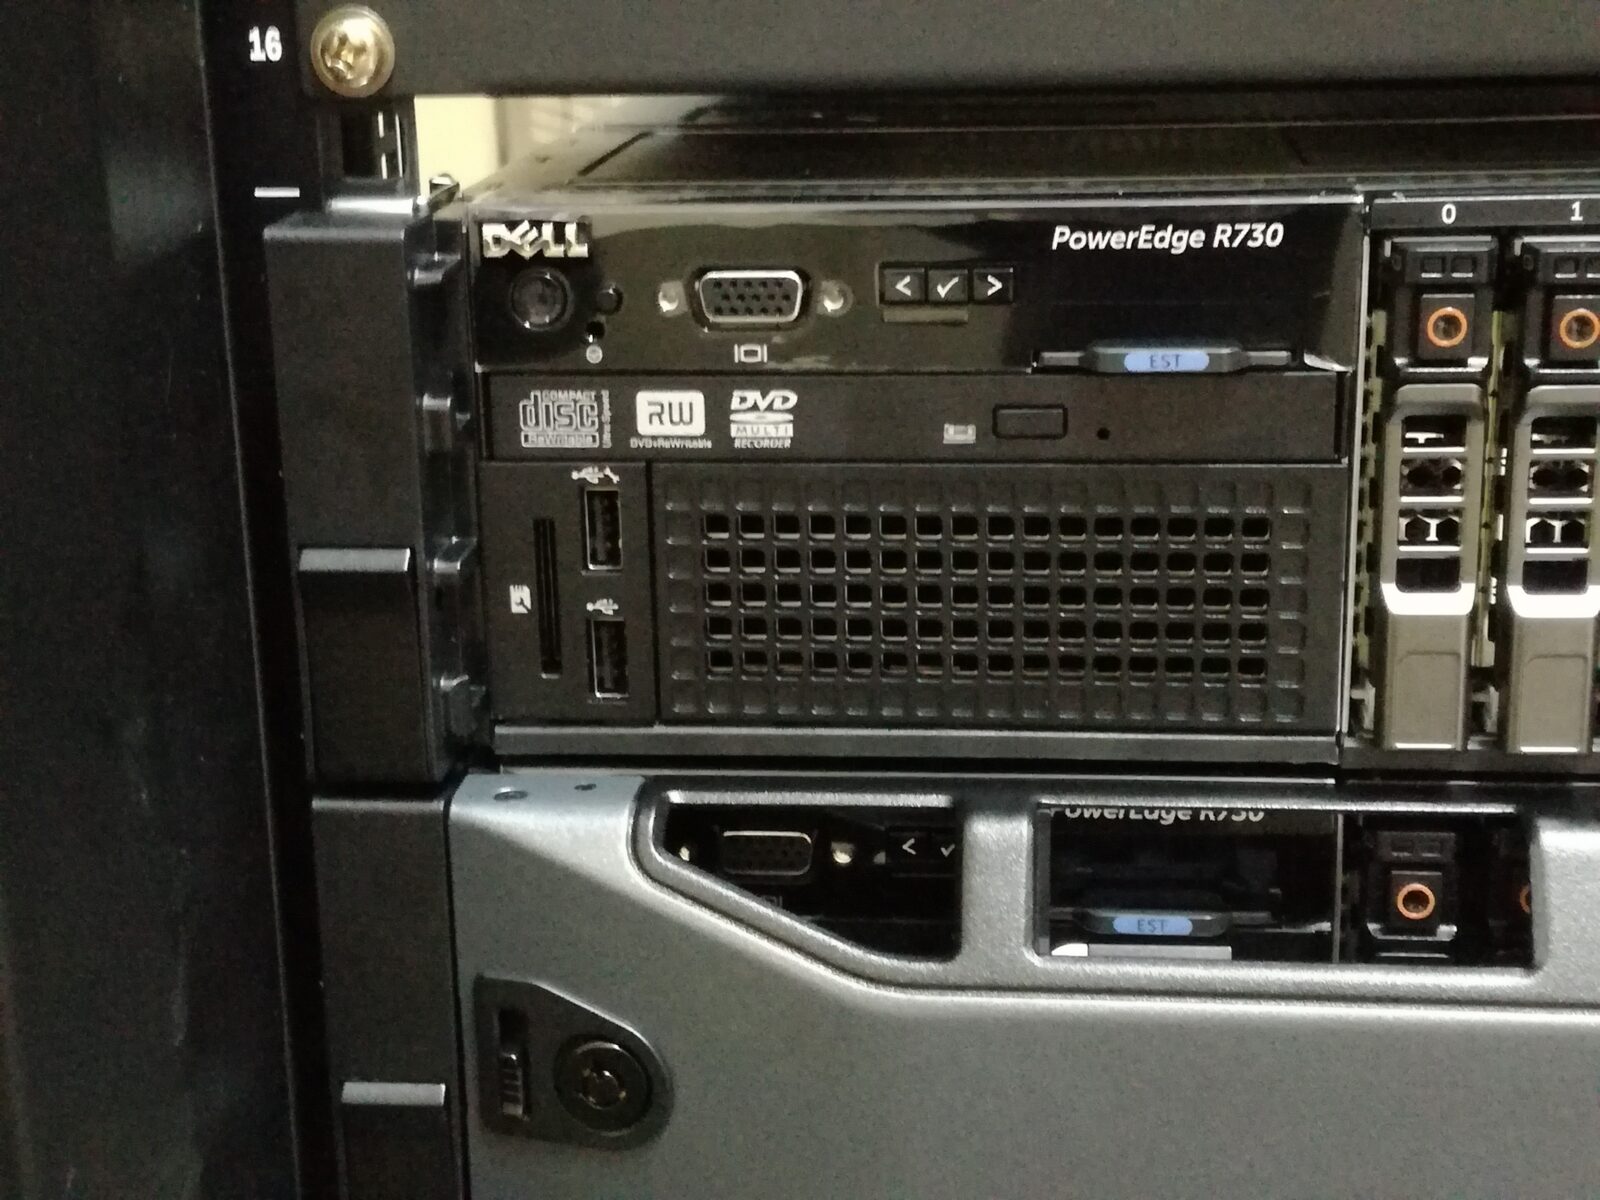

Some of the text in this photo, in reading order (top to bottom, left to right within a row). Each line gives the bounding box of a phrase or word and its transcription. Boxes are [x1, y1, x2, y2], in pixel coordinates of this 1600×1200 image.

[248, 25, 283, 62] 16
[1441, 203, 1457, 225] 0
[1570, 201, 1584, 222] 1
[482, 220, 589, 260] DELL
[1051, 222, 1285, 255] PowerEdge R730
[1149, 353, 1182, 369] EST
[542, 389, 596, 401] COMPACT
[730, 389, 798, 412] DVD
[647, 400, 694, 426] RW
[735, 425, 789, 436] MULTI
[733, 438, 792, 449] RECORDER
[1137, 918, 1168, 933] EST
